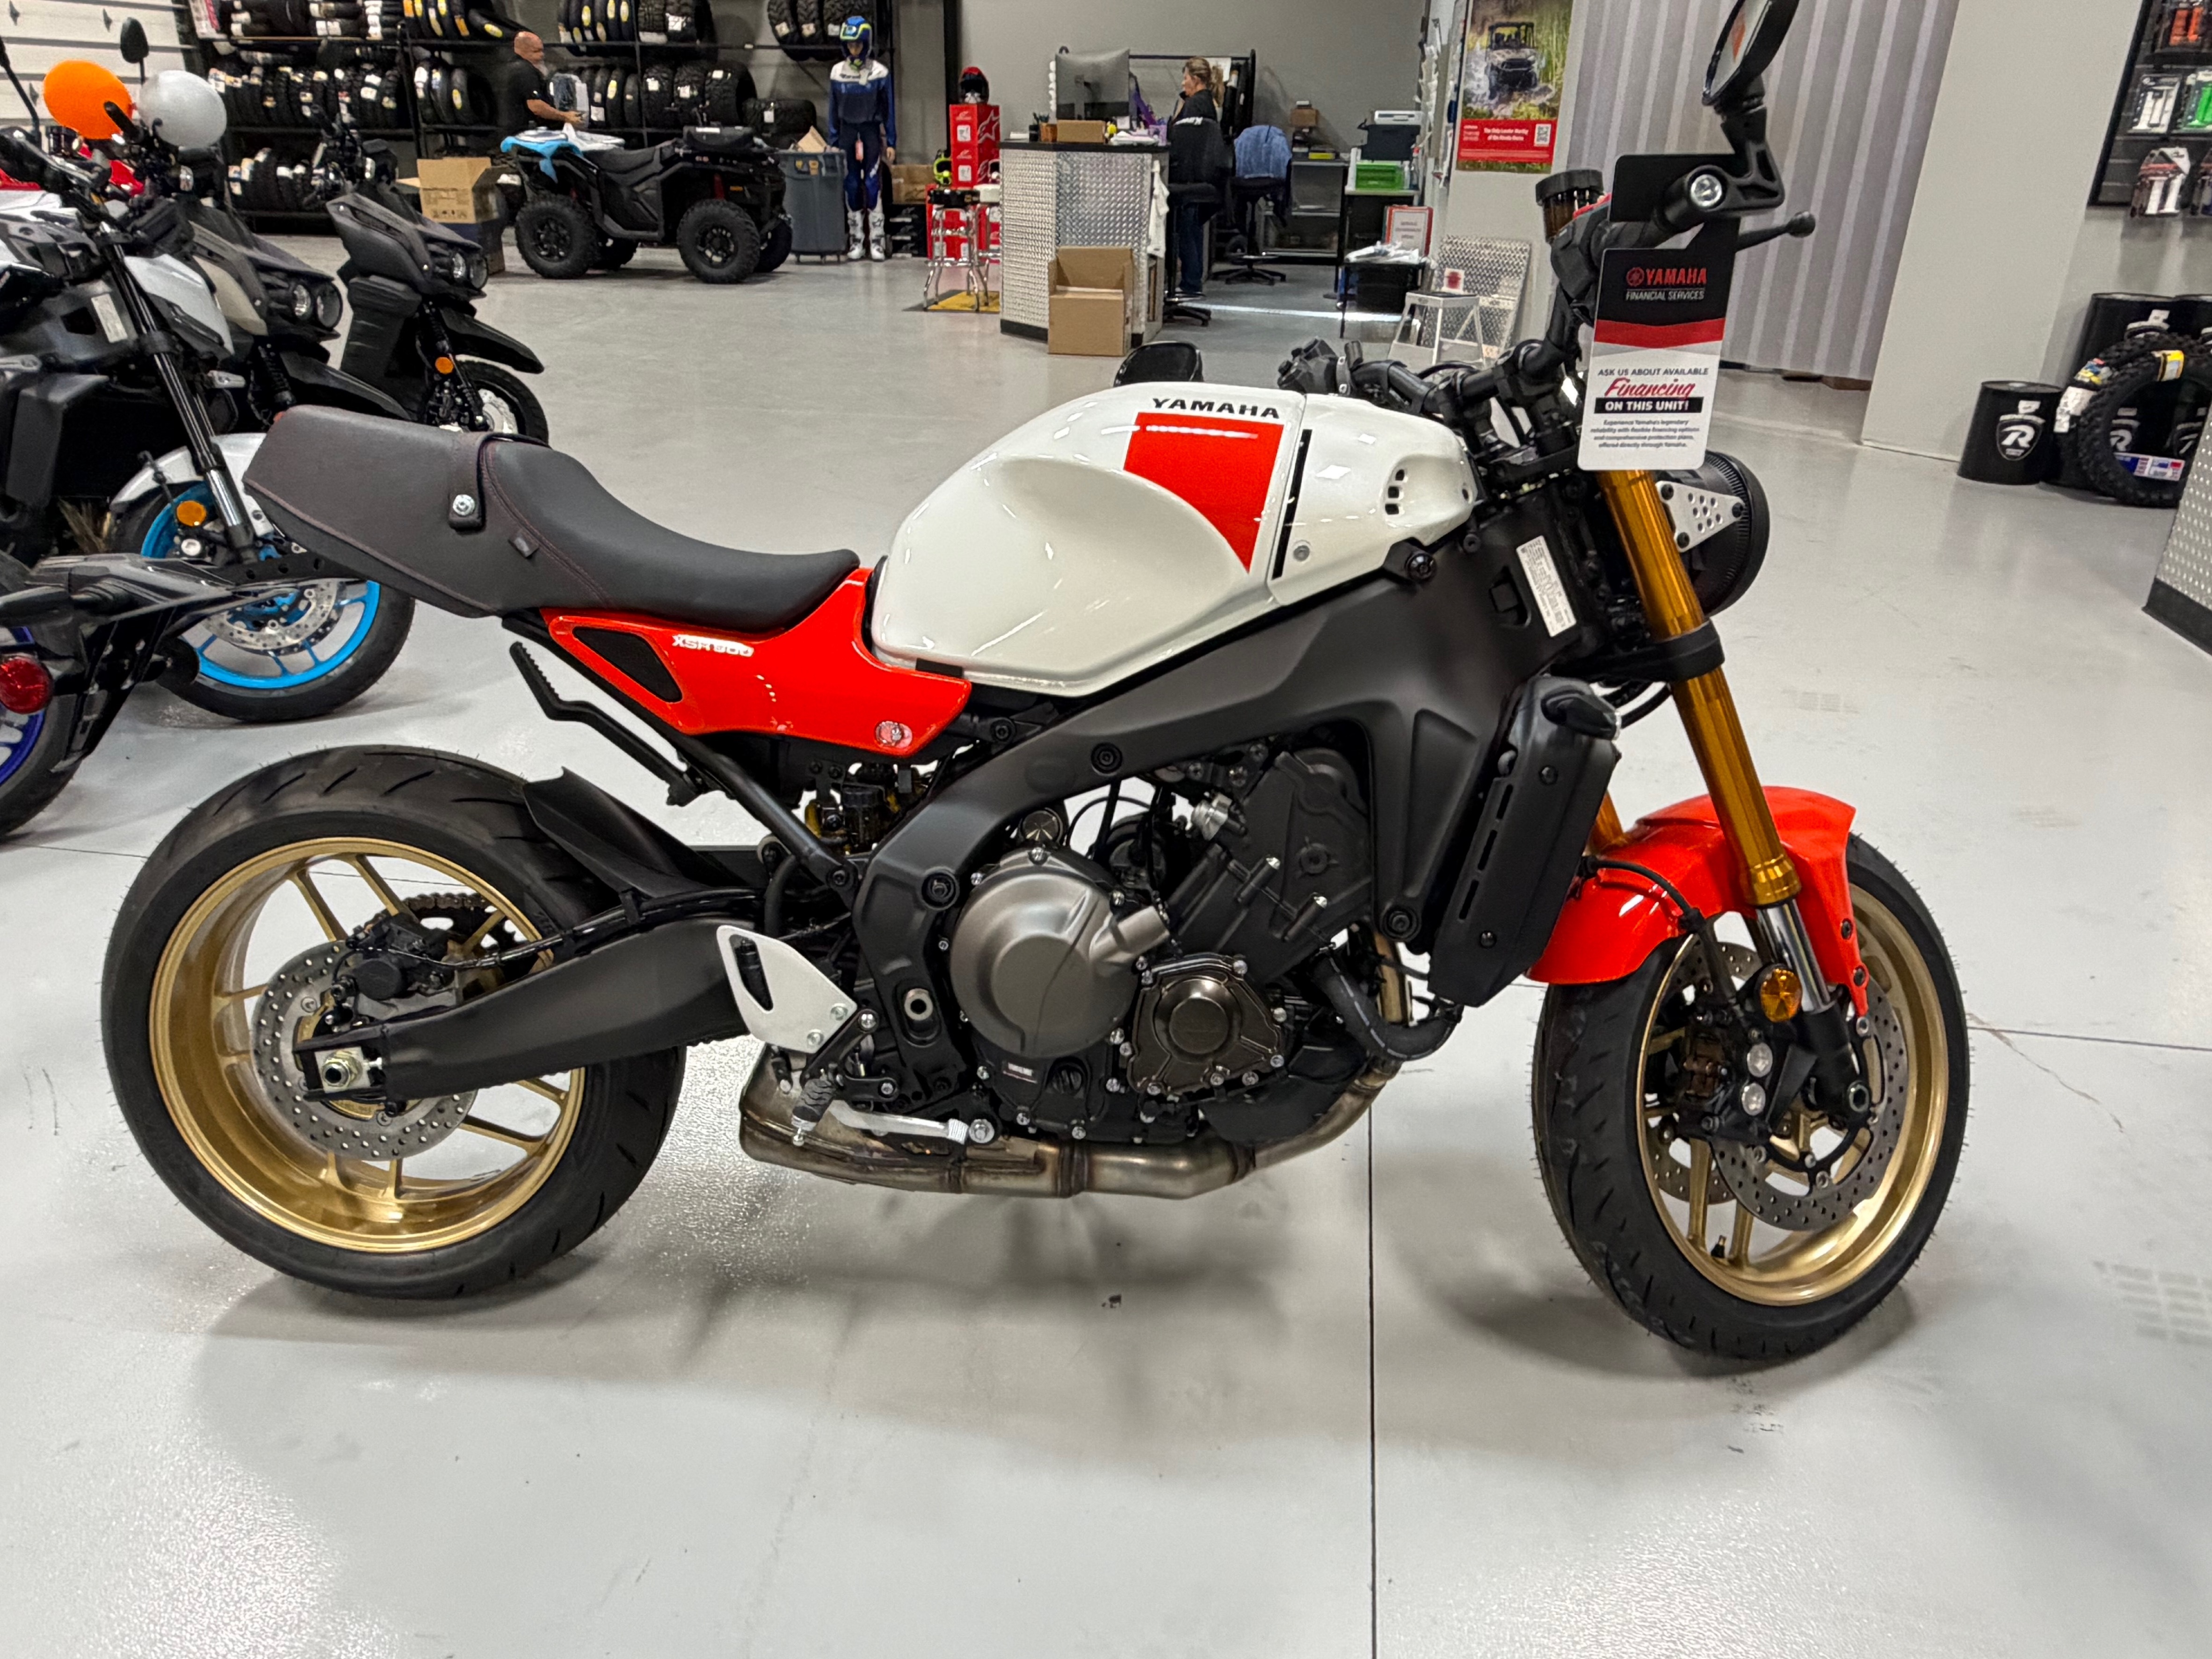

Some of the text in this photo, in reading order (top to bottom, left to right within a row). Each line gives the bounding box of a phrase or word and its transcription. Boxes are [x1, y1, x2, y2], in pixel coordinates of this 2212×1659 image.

[1646, 268, 1707, 285] YAMAHA
[1625, 290, 1705, 301] FINANCIAL SERVICES
[1662, 367, 1709, 376] AVAILABLE
[1604, 377, 1696, 401] Financing
[1153, 398, 1280, 419] YAMAHA
[1605, 400, 1689, 411] ON THIS UNIT!
[672, 634, 755, 657] XSR900
